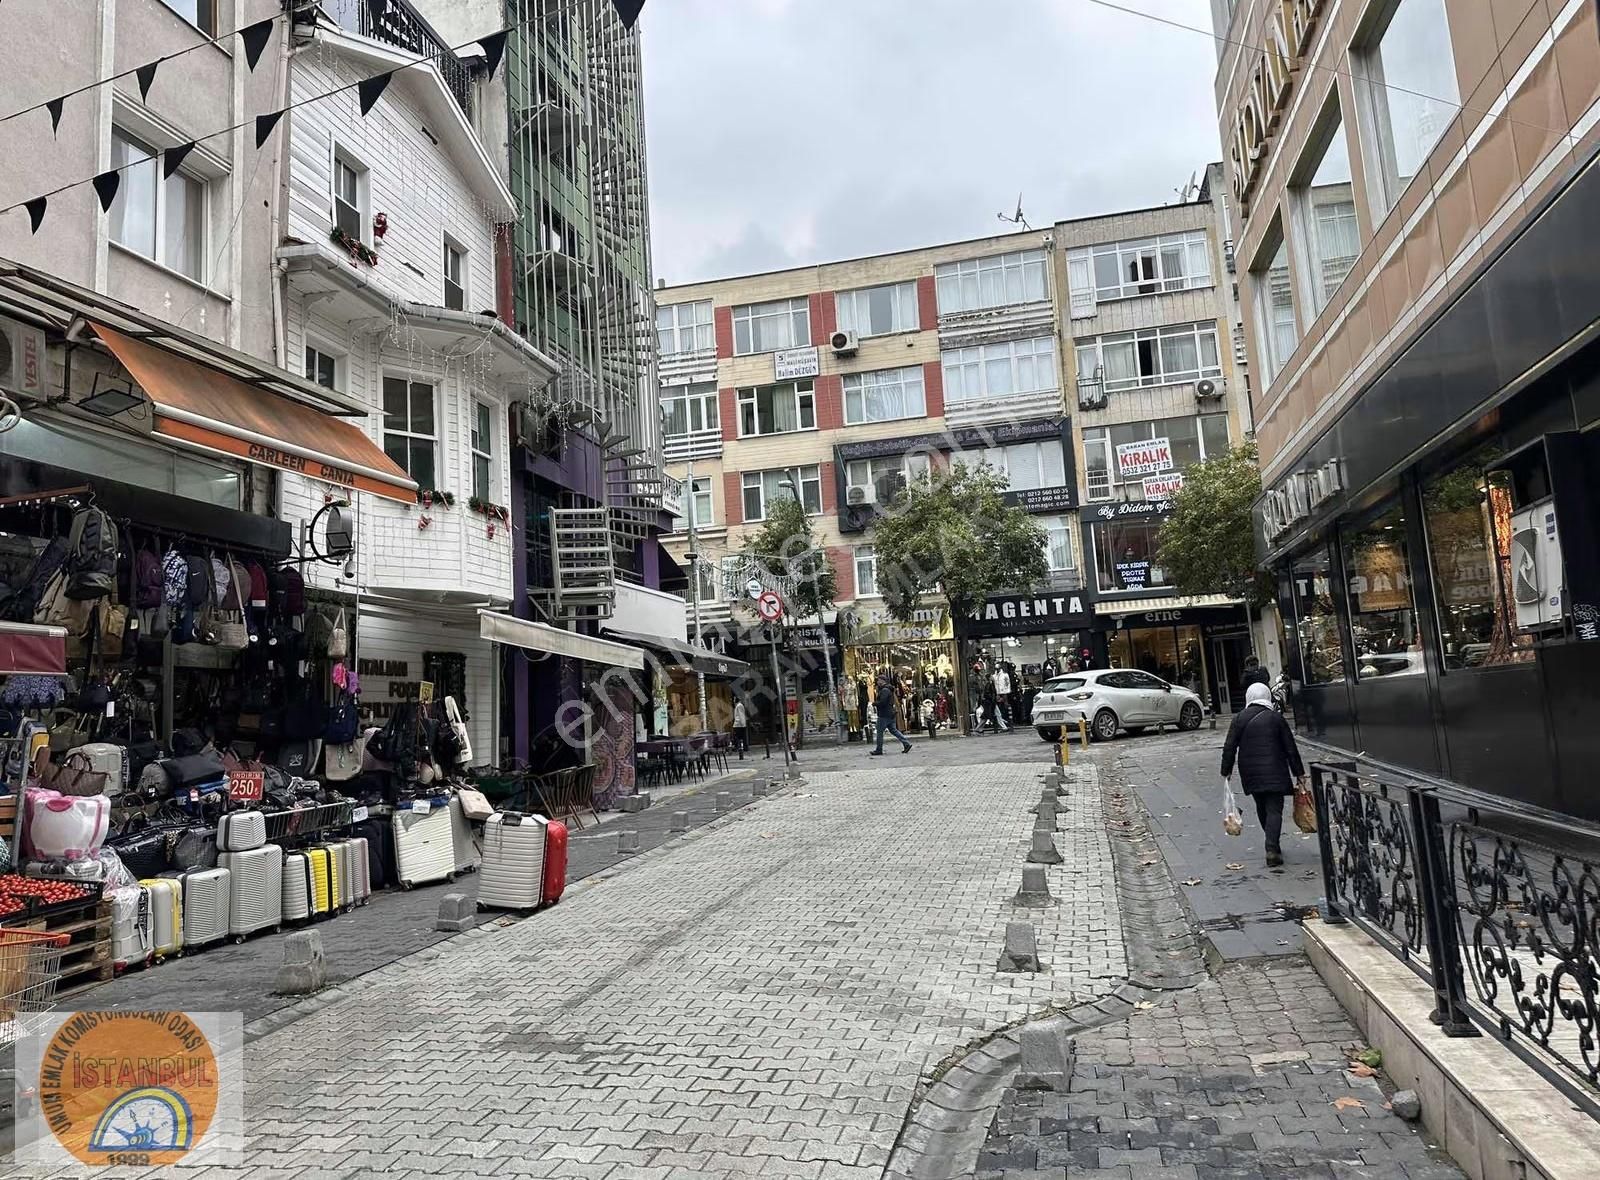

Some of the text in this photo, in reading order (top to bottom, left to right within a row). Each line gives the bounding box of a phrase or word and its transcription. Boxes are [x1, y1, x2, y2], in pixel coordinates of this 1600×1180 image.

[25, 336, 36, 388] VESTEL
[249, 444, 306, 472] CARLEEN
[1122, 466, 1138, 475] 0532
[1140, 464, 1150, 472] 321
[1153, 462, 1160, 470] 27
[1098, 505, 1115, 519] By
[1119, 503, 1154, 513] Didem
[887, 624, 933, 639] Rose
